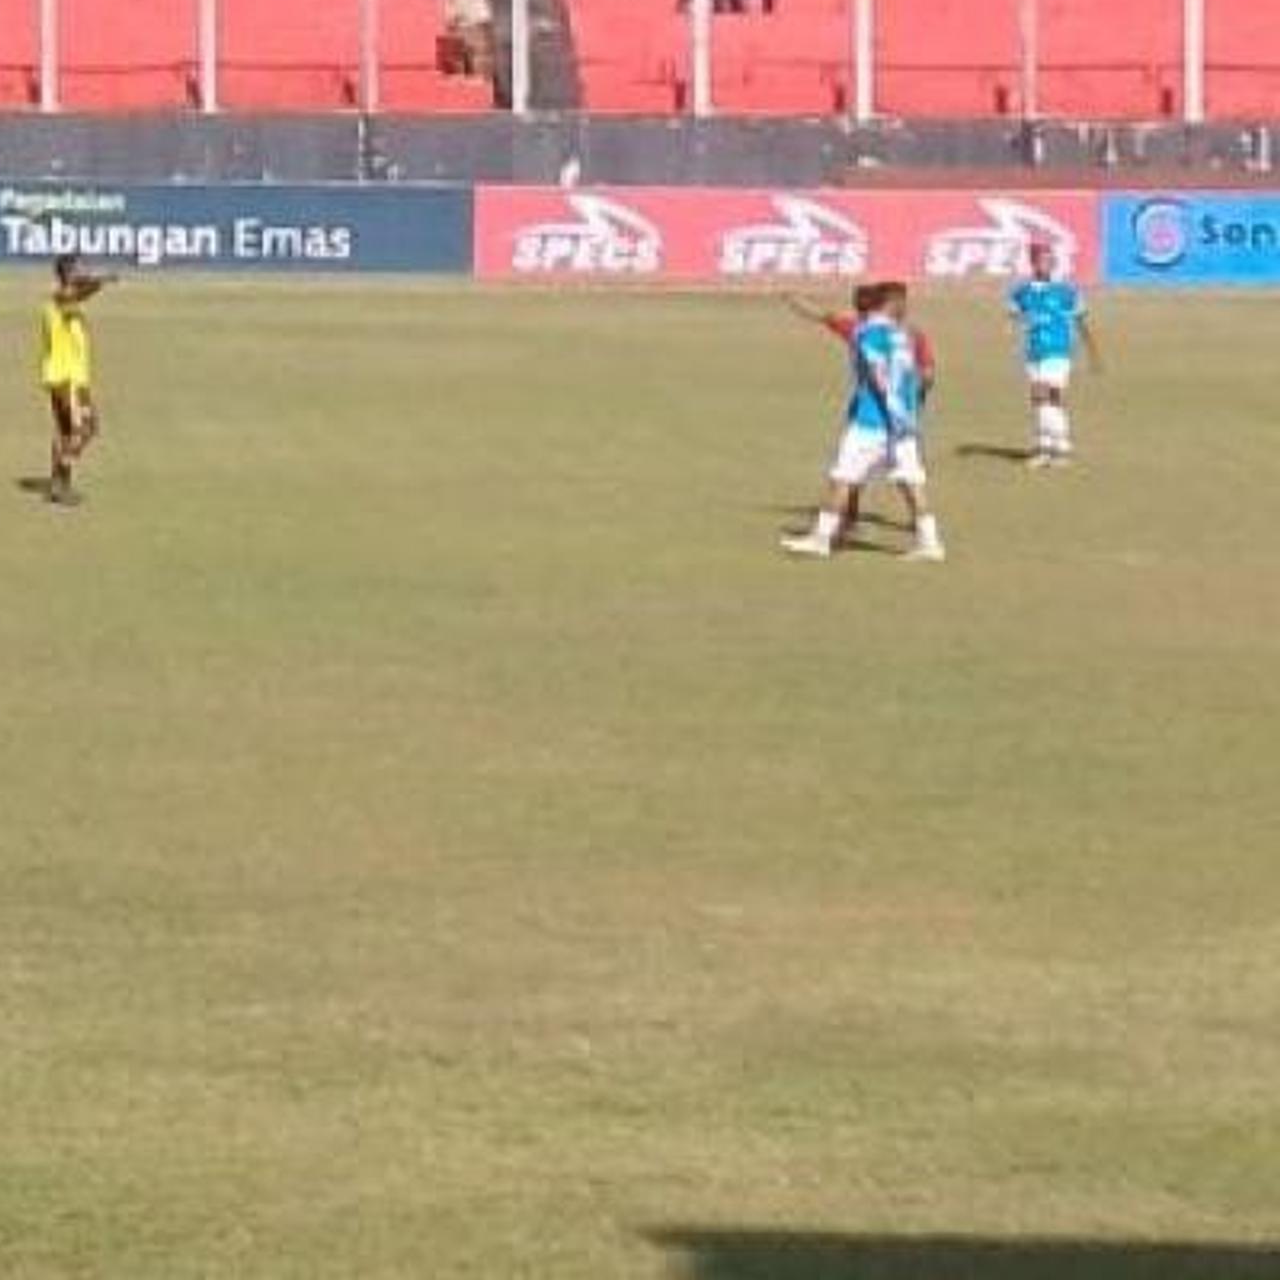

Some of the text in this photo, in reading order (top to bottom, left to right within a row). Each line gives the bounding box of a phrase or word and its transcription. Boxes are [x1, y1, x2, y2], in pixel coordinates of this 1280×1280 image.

[0, 216, 351, 264] Tabungan Emas
[511, 223, 662, 273] SPECS
[719, 227, 867, 274] SPECS
